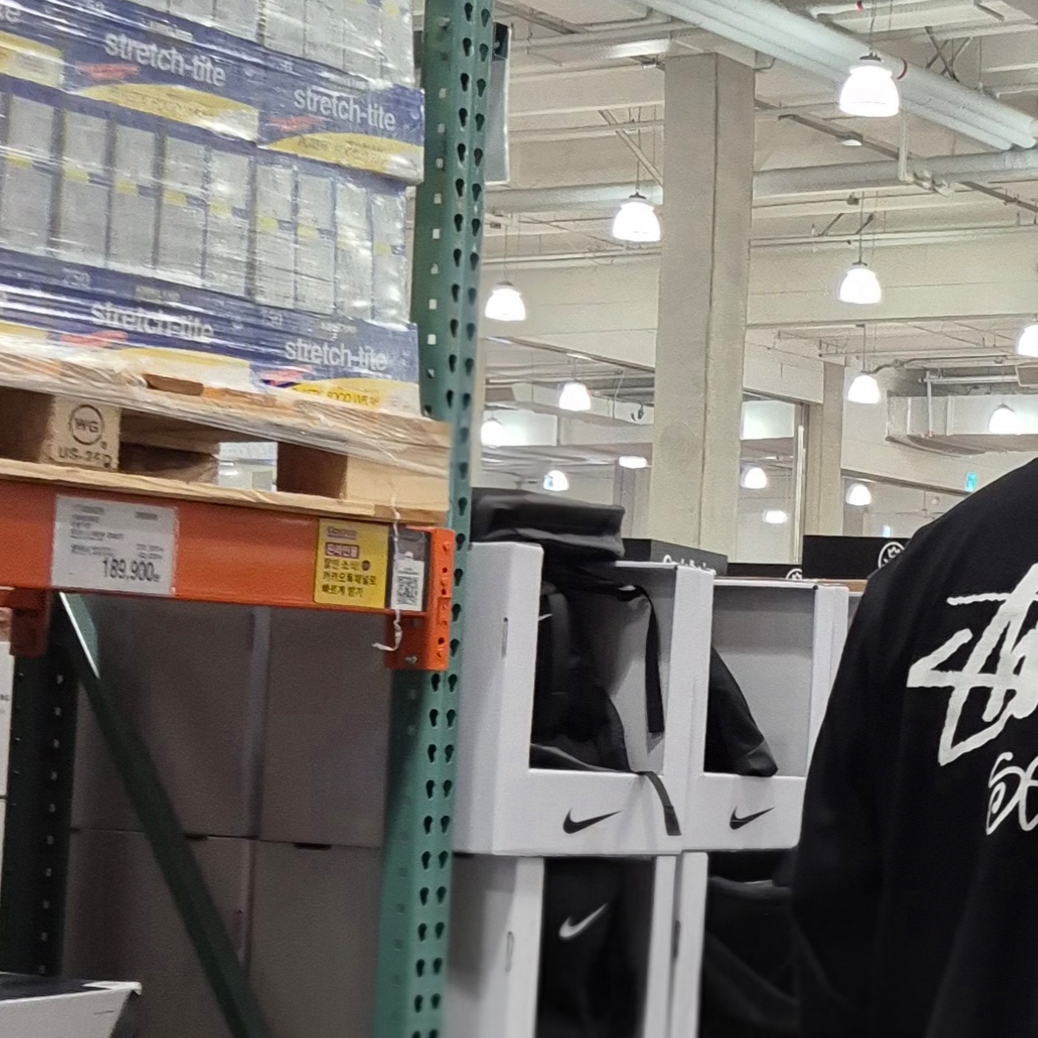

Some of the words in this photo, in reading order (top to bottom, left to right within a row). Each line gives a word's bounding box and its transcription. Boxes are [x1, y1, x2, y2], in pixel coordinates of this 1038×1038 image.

[104, 33, 226, 87] stretch-tite
[293, 87, 396, 132] stretch-tite
[284, 338, 388, 371] stretch-tite
